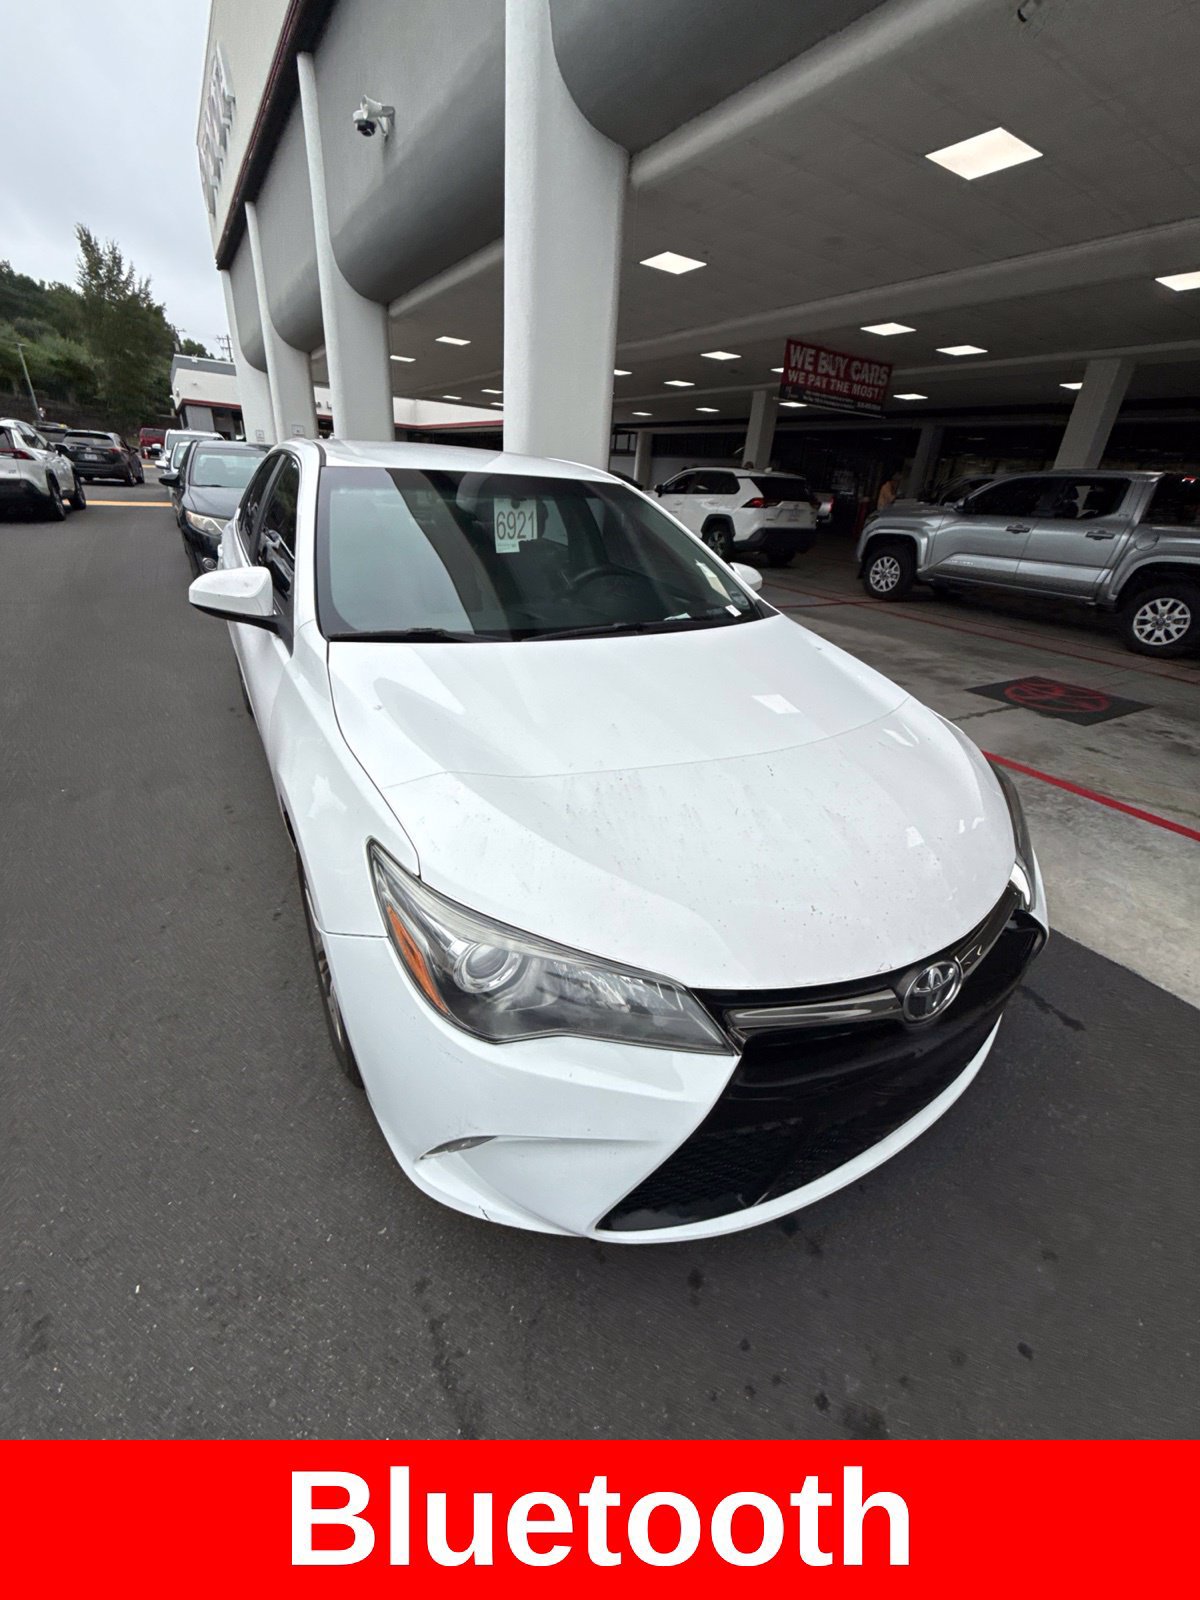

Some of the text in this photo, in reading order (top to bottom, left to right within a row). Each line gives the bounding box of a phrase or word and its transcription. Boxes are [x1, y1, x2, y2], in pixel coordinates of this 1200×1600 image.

[789, 343, 889, 386] WE BUY CARS
[788, 369, 806, 384] WE
[807, 374, 828, 389] PAY
[830, 378, 850, 393] THE
[496, 511, 534, 540] 6921
